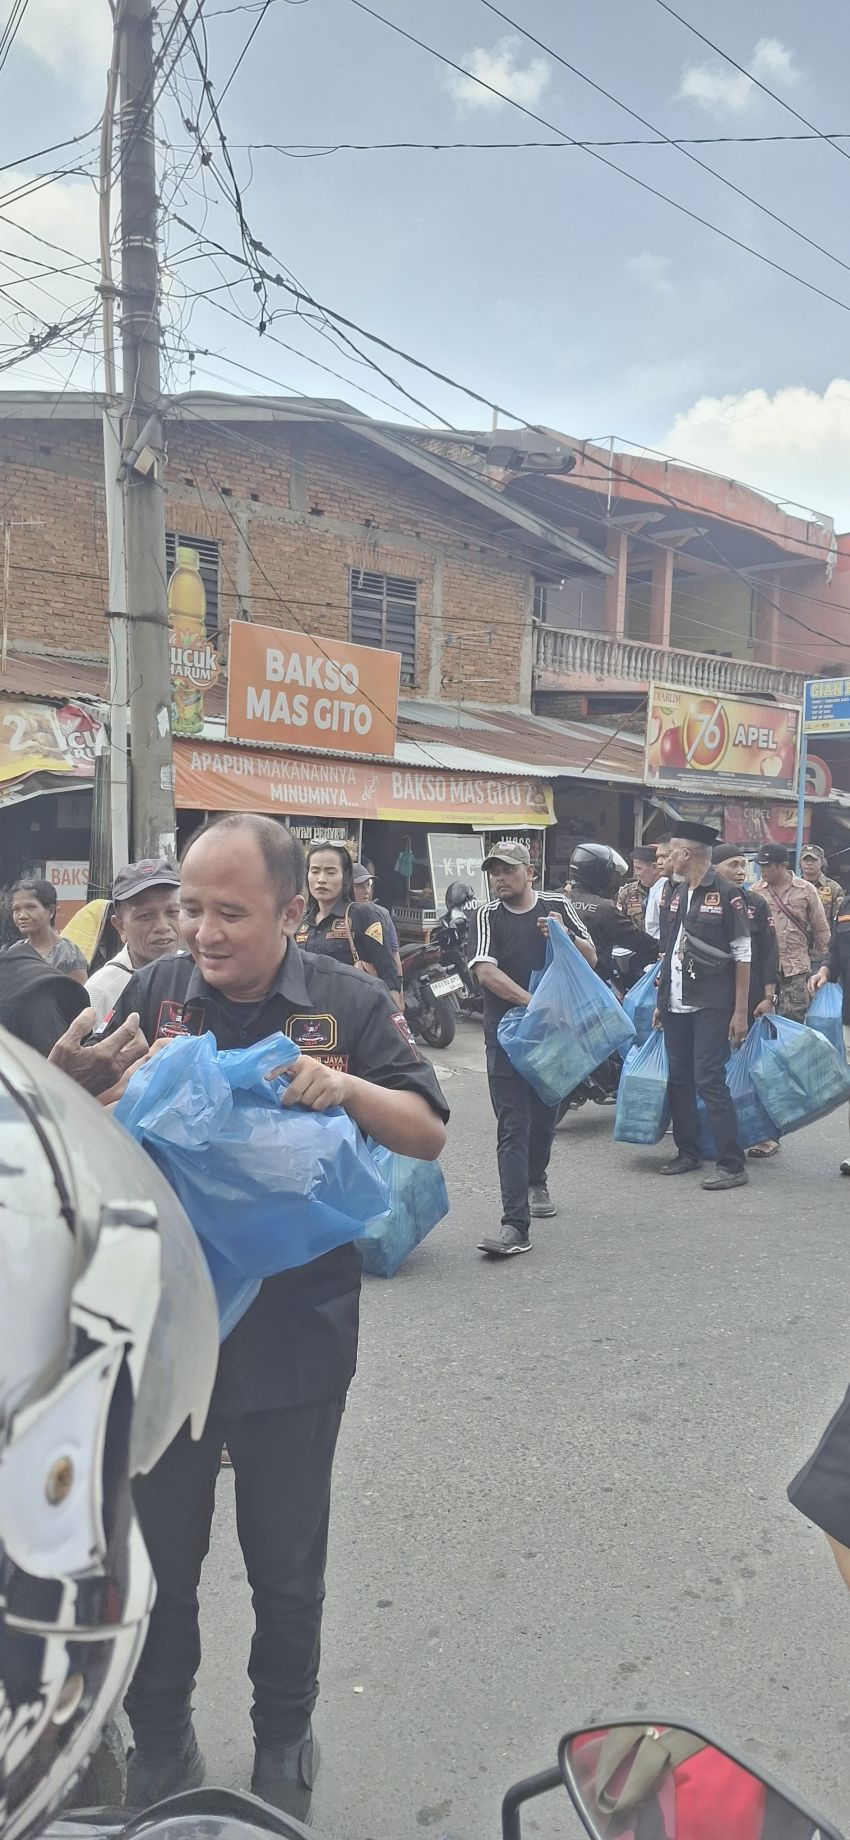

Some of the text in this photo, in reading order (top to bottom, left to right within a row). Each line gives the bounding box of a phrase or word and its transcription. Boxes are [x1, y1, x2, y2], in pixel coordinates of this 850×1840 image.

[169, 645, 217, 670] ucuk
[266, 648, 359, 695] BAKSO
[246, 686, 373, 736] MAS GITO
[733, 724, 777, 749] APEL
[191, 752, 357, 785] APAPUN MAKANANNYA
[392, 771, 446, 803] BAKSO
[450, 777, 484, 805] MAS
[487, 781, 522, 806] GITO
[743, 808, 771, 819] CAMEL
[51, 868, 89, 885] BAKS
[324, 1056, 343, 1065] JAYA
